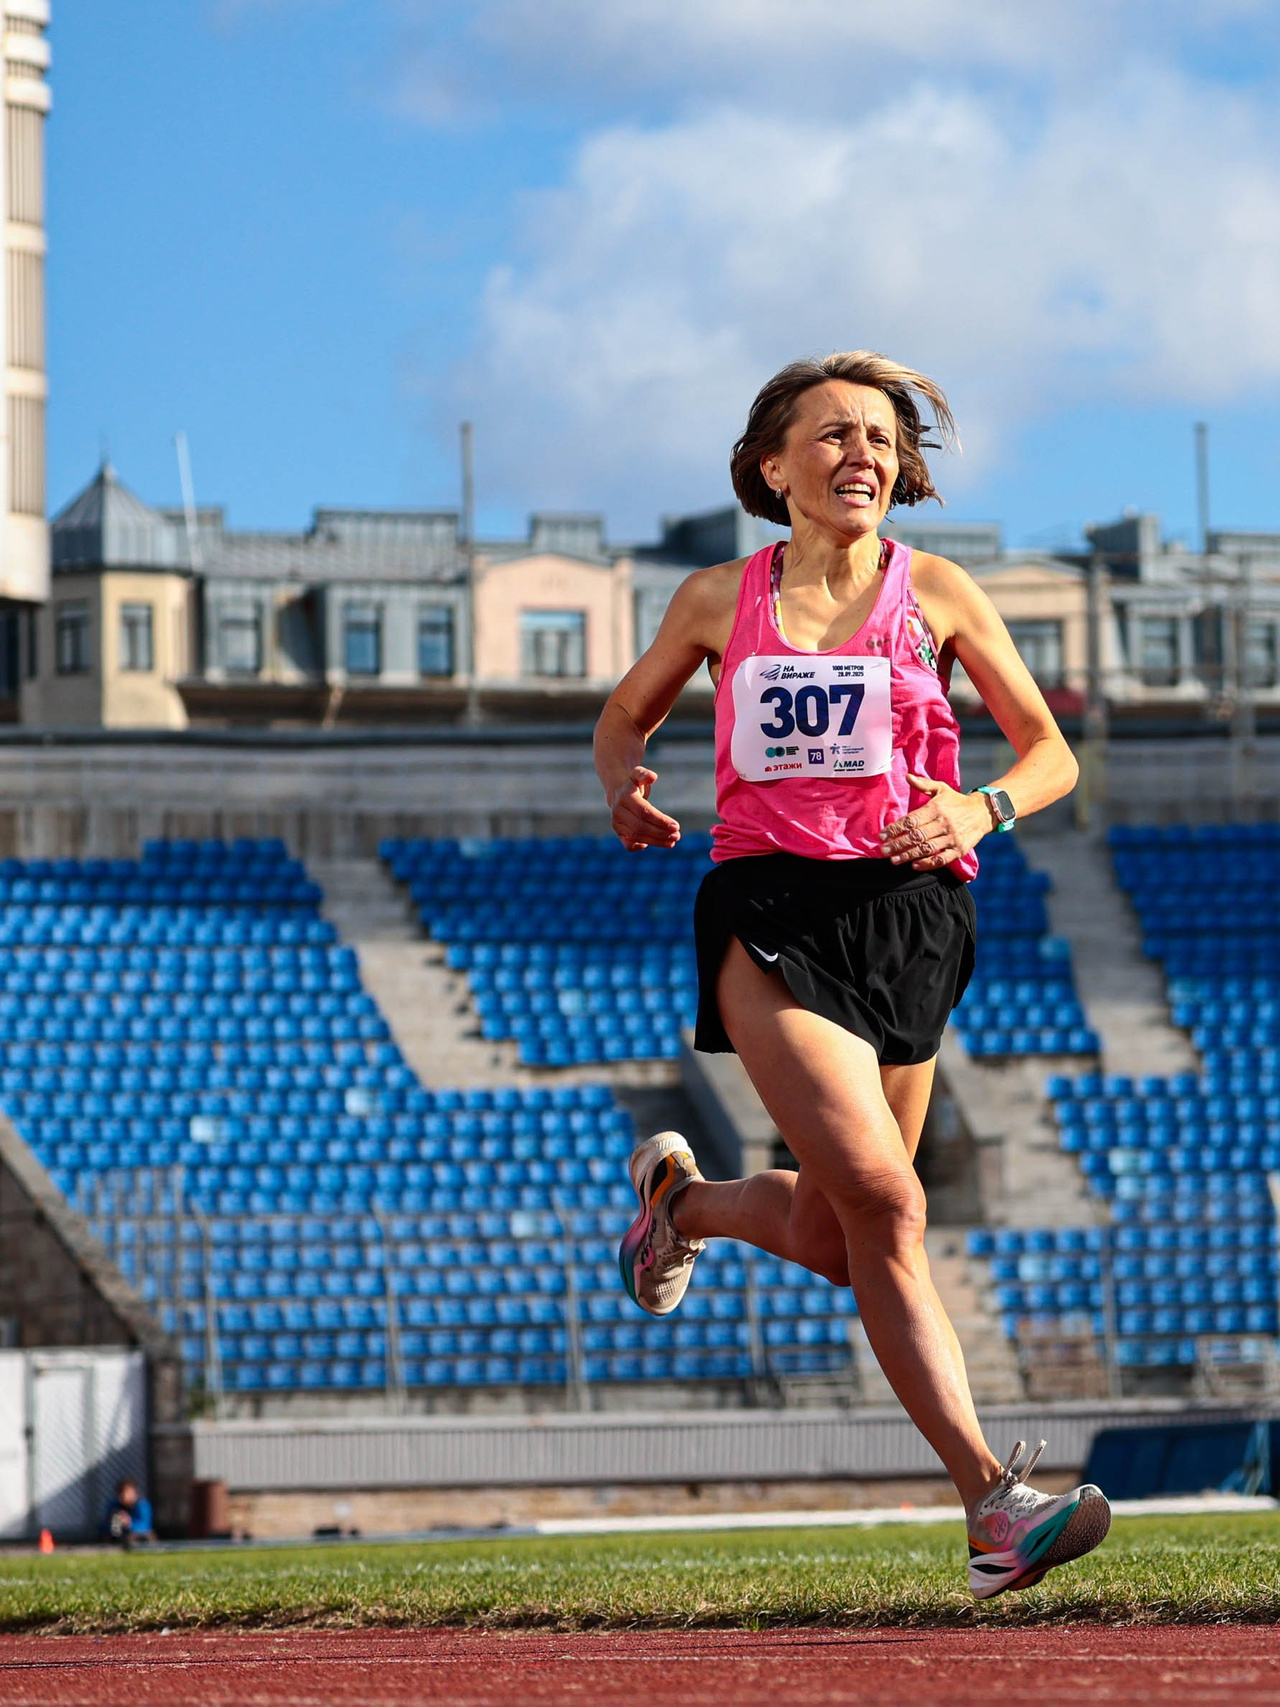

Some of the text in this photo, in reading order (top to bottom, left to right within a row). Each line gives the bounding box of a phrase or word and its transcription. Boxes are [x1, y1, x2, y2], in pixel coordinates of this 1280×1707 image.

[781, 671, 816, 679] ВИРАЖЕ
[760, 684, 865, 739] 307
[810, 752, 822, 761] 78
[772, 762, 803, 771] этажи
